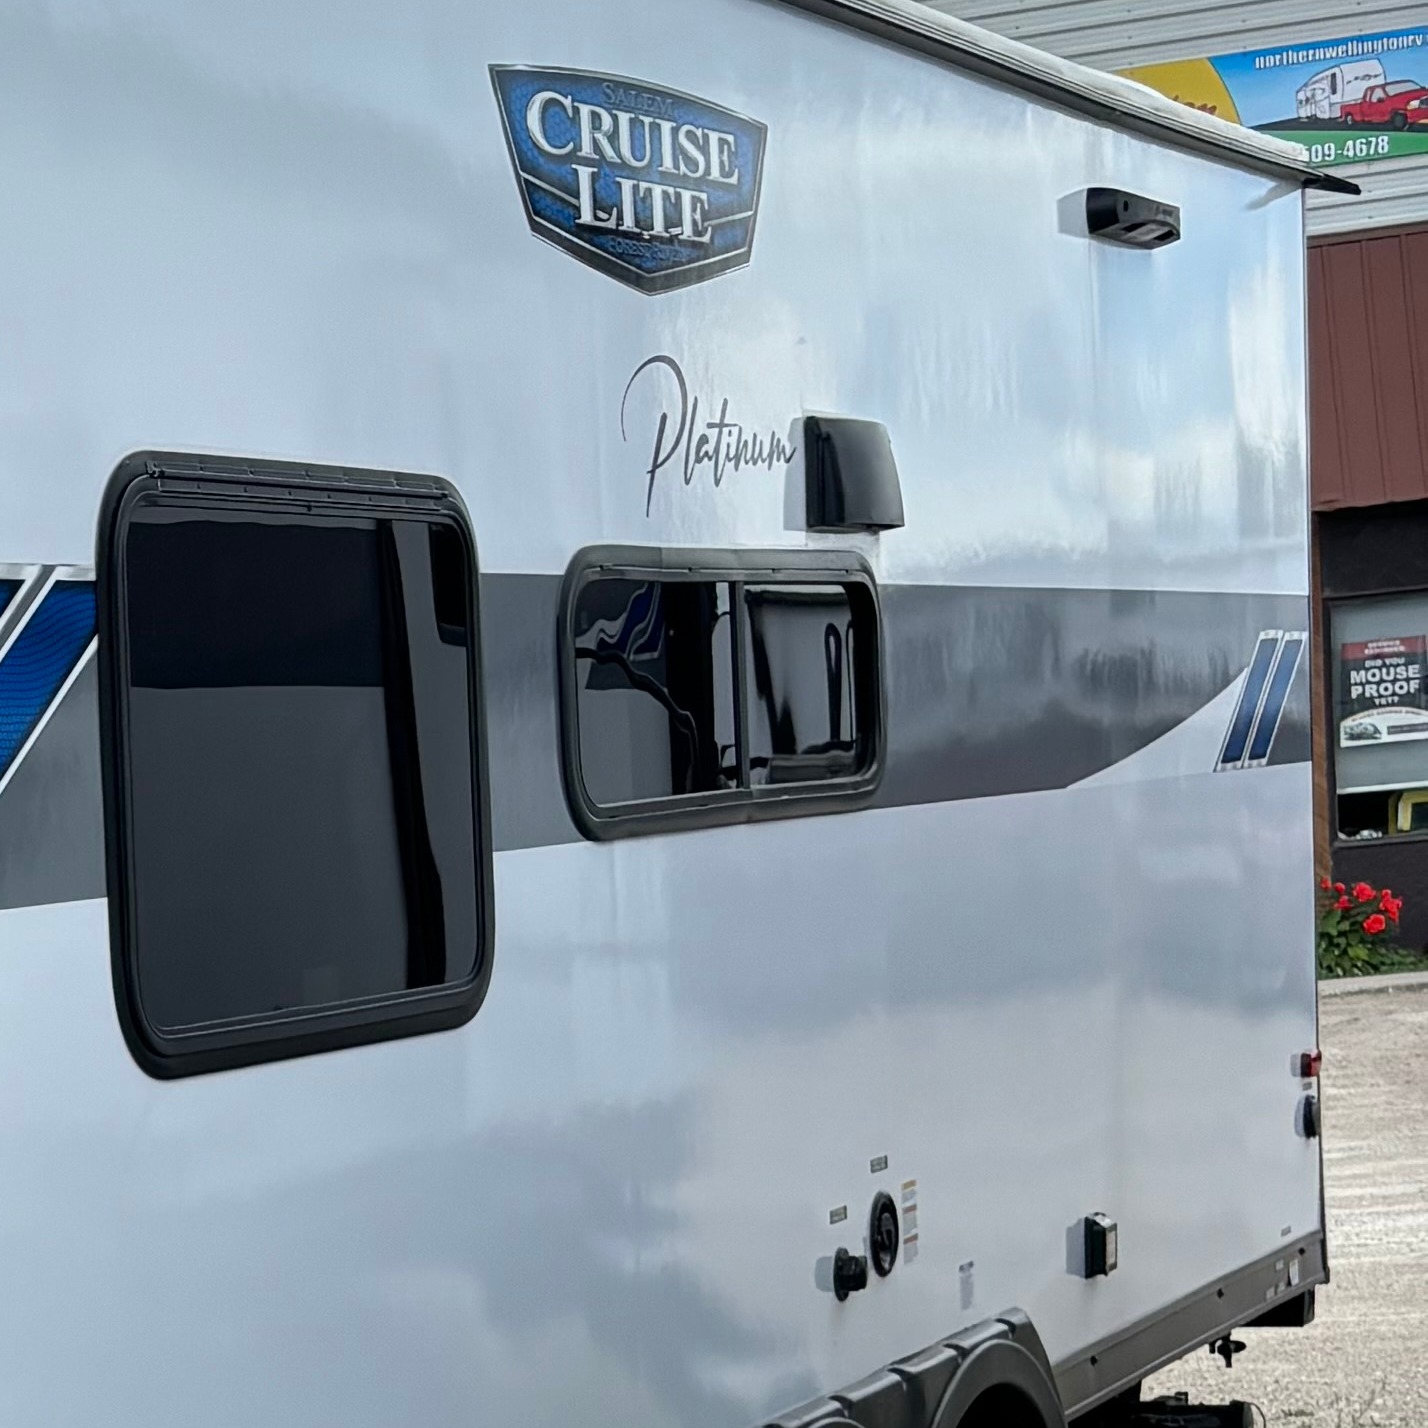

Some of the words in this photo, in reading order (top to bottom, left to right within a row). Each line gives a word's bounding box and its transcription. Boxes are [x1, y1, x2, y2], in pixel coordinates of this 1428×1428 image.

[1255, 34, 1428, 69] northernwellingtonrv
[526, 91, 739, 185] CRUISE
[571, 164, 712, 243] LITE
[621, 355, 796, 518] Platinum
[1350, 664, 1421, 685] MOUSE
[1385, 657, 1406, 666] YOU
[1350, 680, 1420, 700] PROOF
